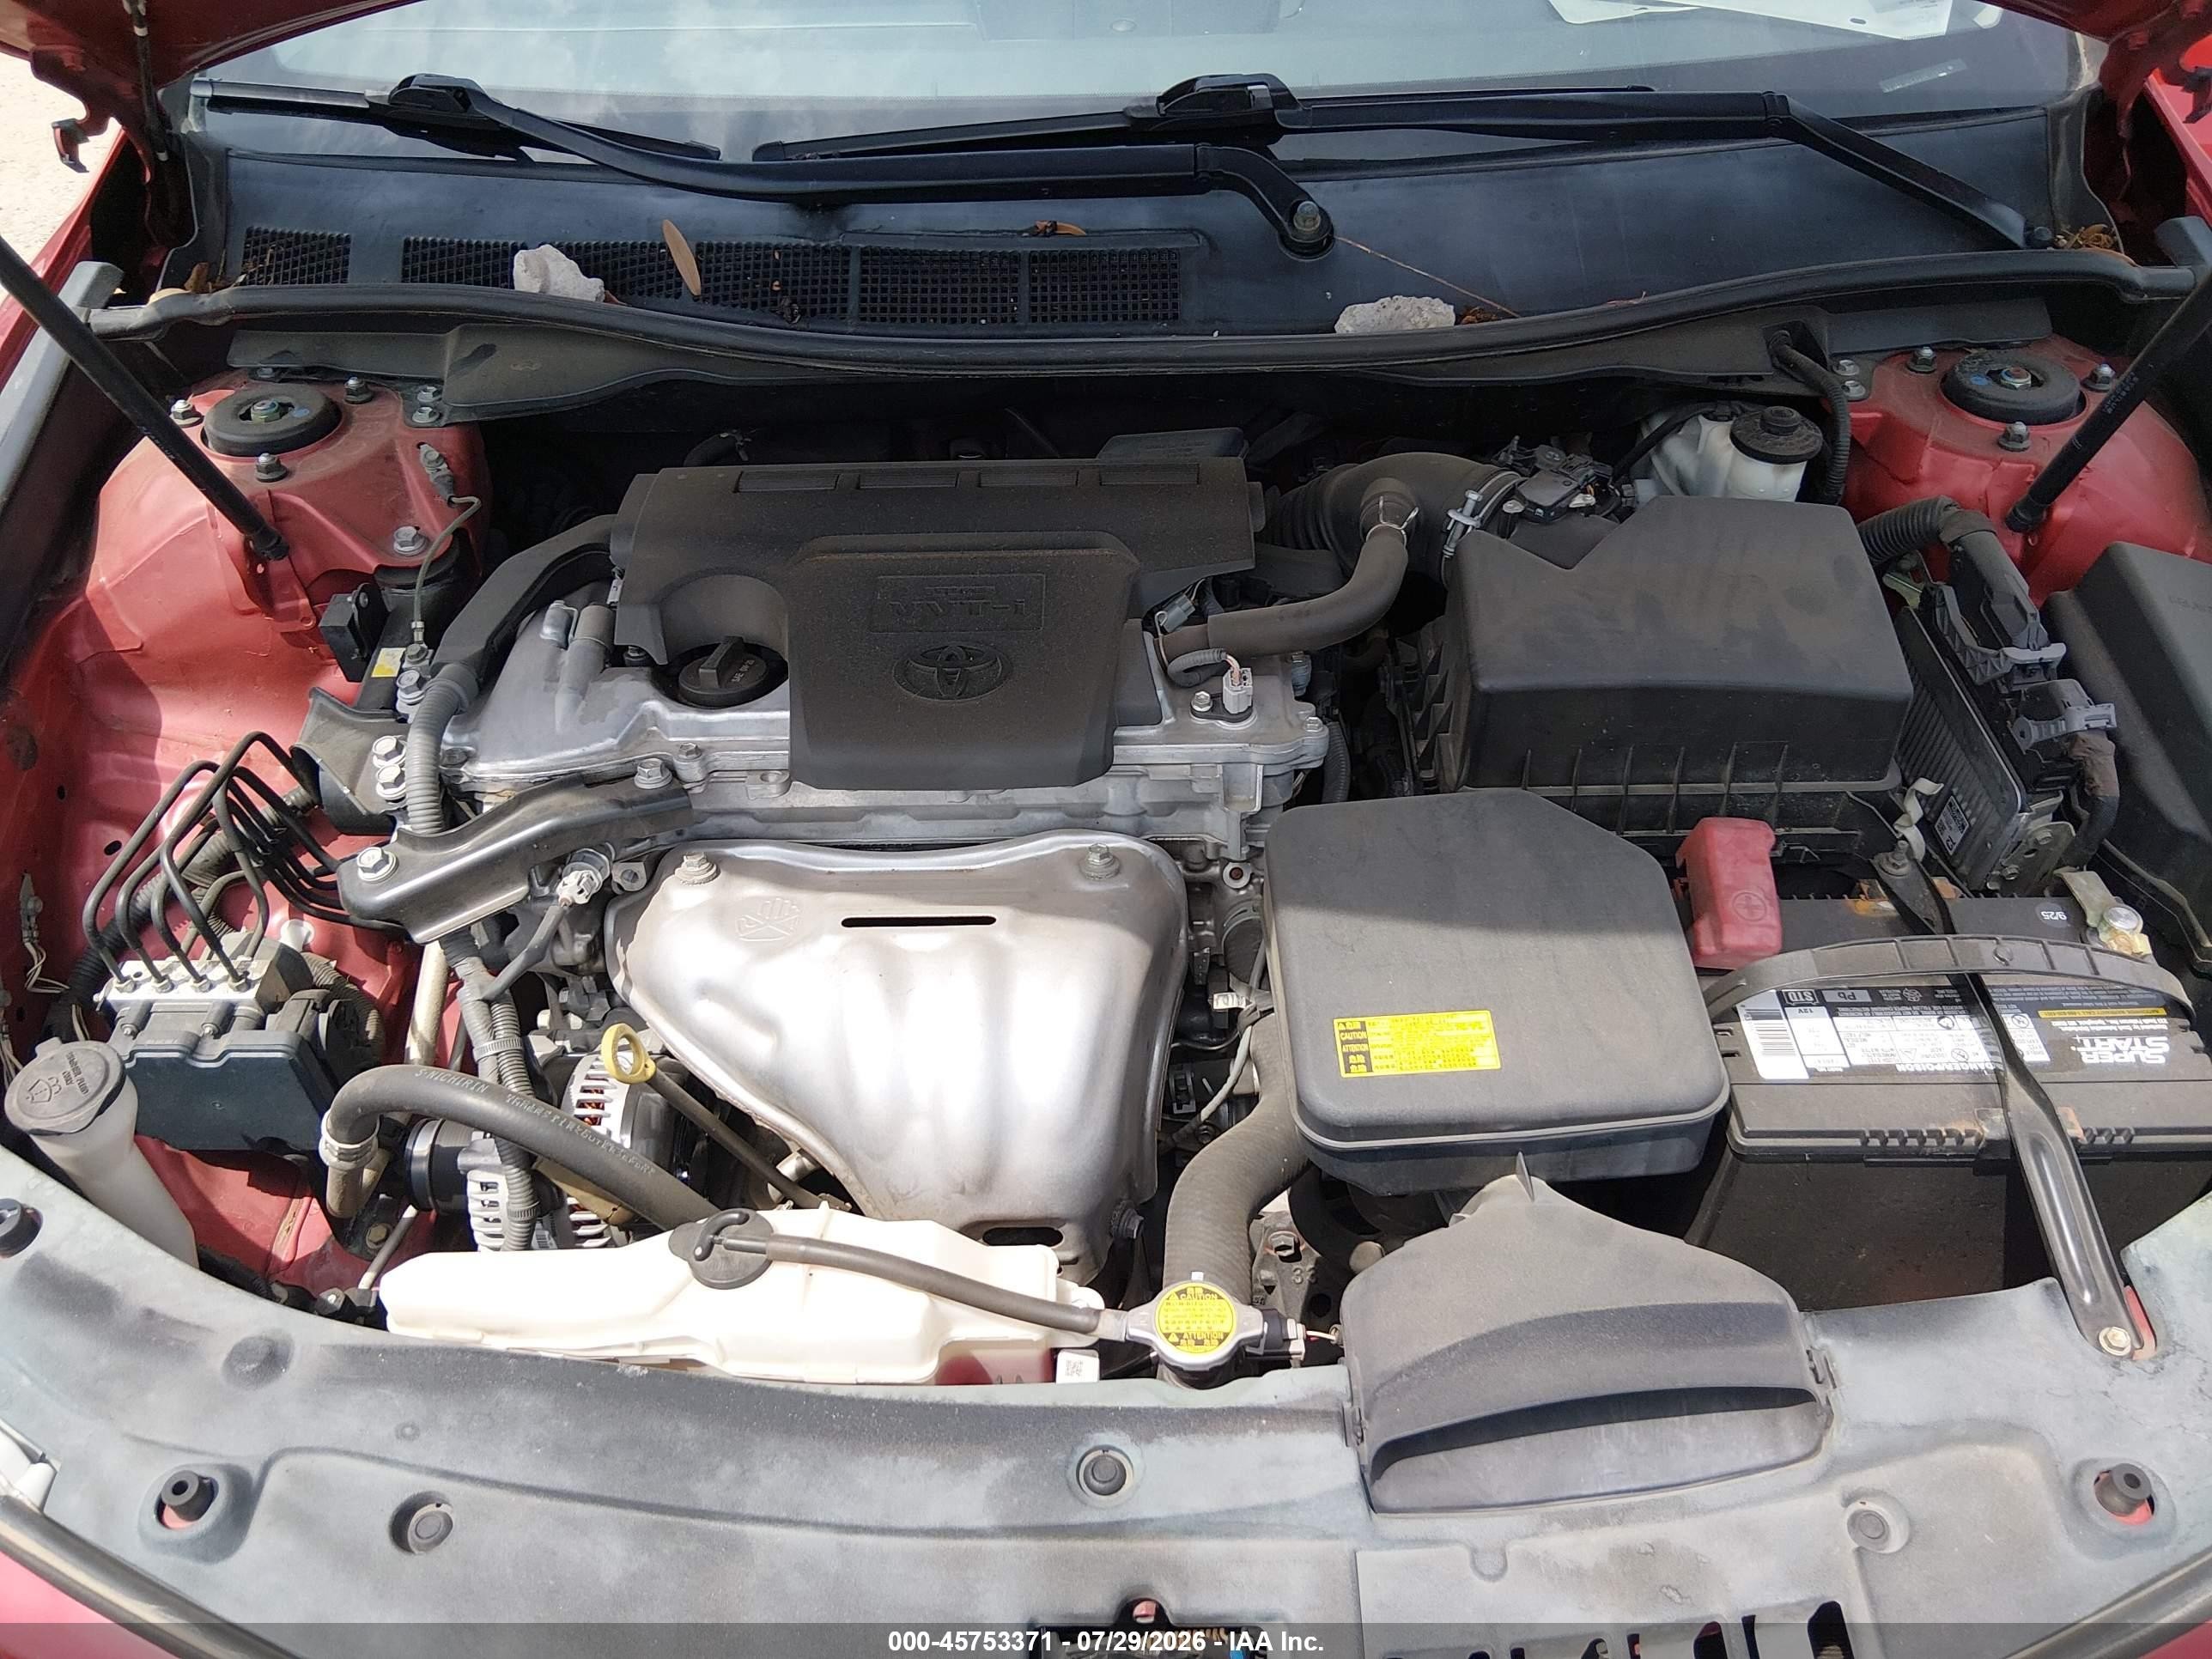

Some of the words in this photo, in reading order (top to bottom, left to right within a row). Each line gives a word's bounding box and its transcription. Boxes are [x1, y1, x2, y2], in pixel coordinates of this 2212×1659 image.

[2040, 911, 2068, 921] 9/25
[1788, 991, 1814, 1002] STD
[1838, 991, 1856, 1000] Pb
[1340, 1031, 1367, 1041] CAUTION
[2075, 1036, 2169, 1052] START
[2080, 1050, 2166, 1064] SUPER
[1182, 1332, 1224, 1340] ATTENTION
